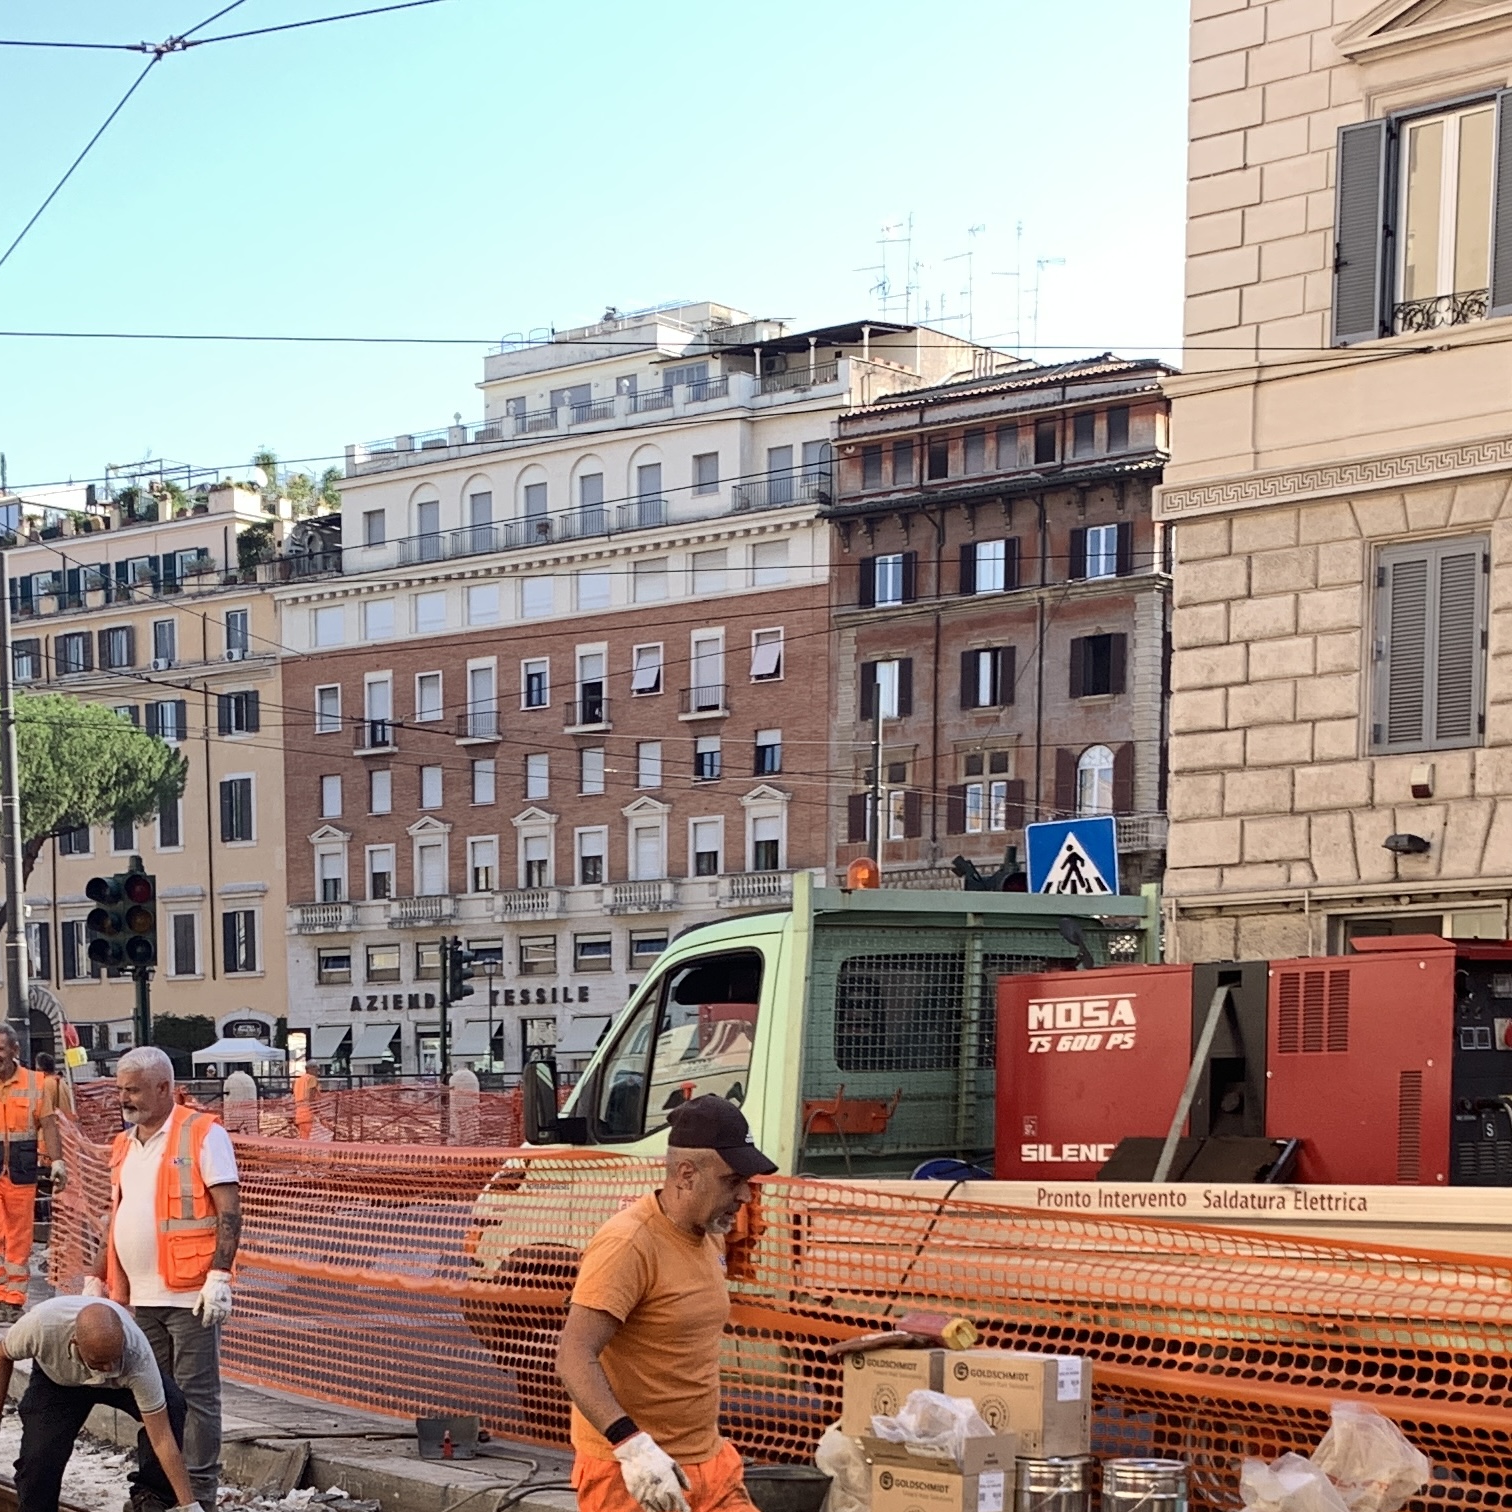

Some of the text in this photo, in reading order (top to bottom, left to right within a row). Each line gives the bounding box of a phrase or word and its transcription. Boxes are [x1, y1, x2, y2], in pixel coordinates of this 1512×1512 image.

[350, 986, 590, 1011] AZIEND TESSILE
[1028, 999, 1137, 1030] MOSA
[1028, 1032, 1136, 1053] TS 600 PS
[1021, 1143, 1116, 1162] SILENC
[1038, 1188, 1368, 1212] Pronto Intervento Saldatura Elettrica
[866, 1358, 918, 1371] GOLDSCHMIDT
[970, 1368, 1030, 1382] GOLDSCHMIDT
[894, 1478, 950, 1494] GOLDSCHMIDT
